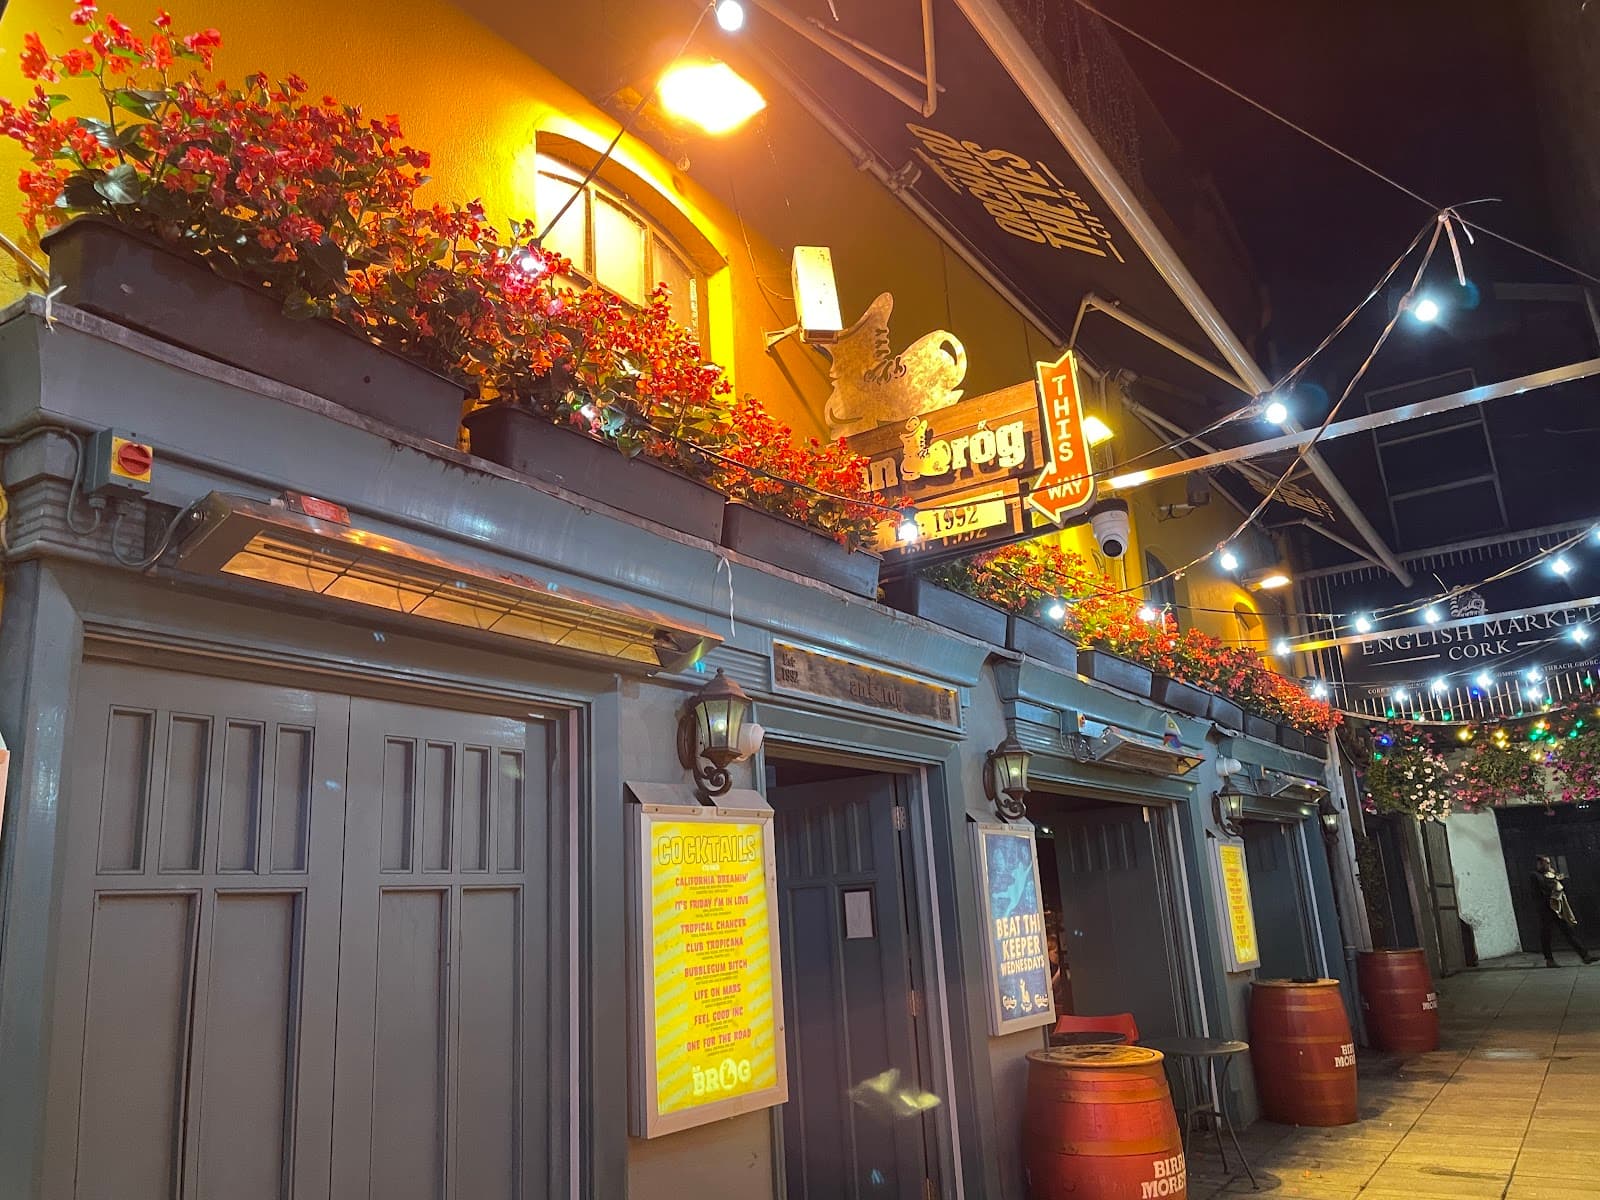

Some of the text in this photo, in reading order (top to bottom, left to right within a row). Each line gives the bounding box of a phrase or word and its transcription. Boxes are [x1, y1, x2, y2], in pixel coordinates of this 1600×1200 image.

[905, 122, 1047, 244] ORCHARD
[959, 140, 1107, 257] THIEVES
[1051, 374, 1074, 462] THIS
[1047, 473, 1083, 500] WAY
[933, 504, 979, 533] 1992
[1361, 604, 1597, 656] ENGLISH MARKET
[1448, 639, 1513, 661] CORK
[657, 834, 757, 865] COCKTAILS
[675, 875, 715, 887] CALIFORNIA
[690, 897, 712, 909] FRIDAY
[726, 896, 733, 906] IN
[681, 922, 713, 935] TROPICAL
[996, 915, 1021, 939] BEAT
[686, 937, 744, 953] CLUB TROPICANA
[1002, 935, 1041, 960] KEEPER
[684, 962, 726, 978] BUBBLEGUM
[728, 959, 748, 970] BITCH
[1000, 955, 1045, 976] WEDNESDAYS
[694, 983, 741, 1000] LIFE ON MARS
[694, 1013, 709, 1026] FEEL
[713, 1009, 730, 1021] GOOD
[733, 1006, 743, 1016] INC
[687, 1040, 700, 1052] ONE
[703, 1037, 716, 1048] FOR
[719, 1033, 731, 1044] THE
[734, 1028, 752, 1040] ROAD
[1141, 1169, 1187, 1199] MORE
